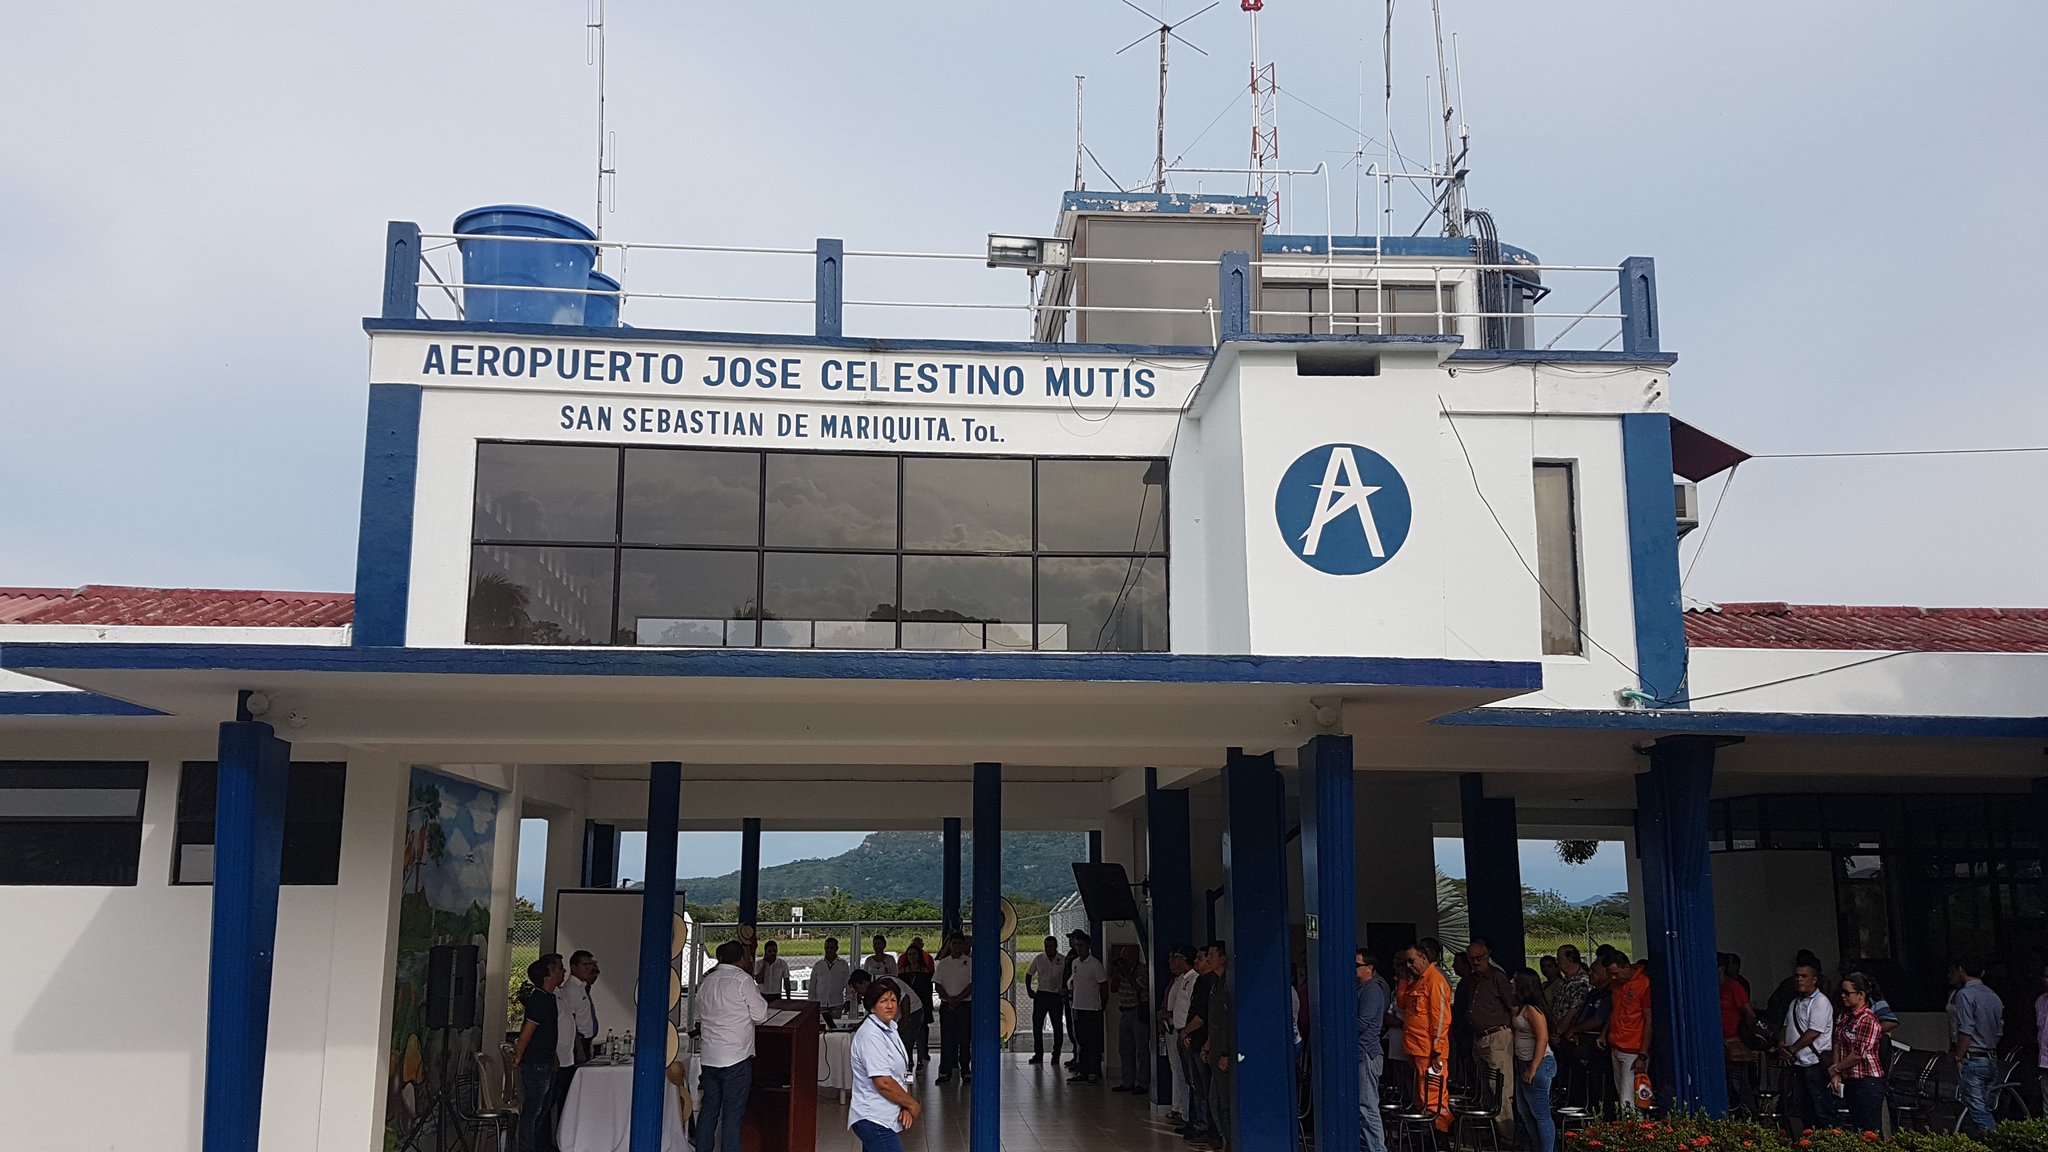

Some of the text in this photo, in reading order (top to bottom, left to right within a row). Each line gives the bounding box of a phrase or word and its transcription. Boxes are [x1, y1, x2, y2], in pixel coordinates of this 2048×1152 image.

[422, 343, 1156, 399] AEROPUERTO JOSE CELESTINO MUTIS
[560, 405, 612, 431] SAN
[623, 407, 763, 437] SEBASTIAN
[777, 413, 809, 438] DE
[821, 414, 956, 444] MARIQUITA.
